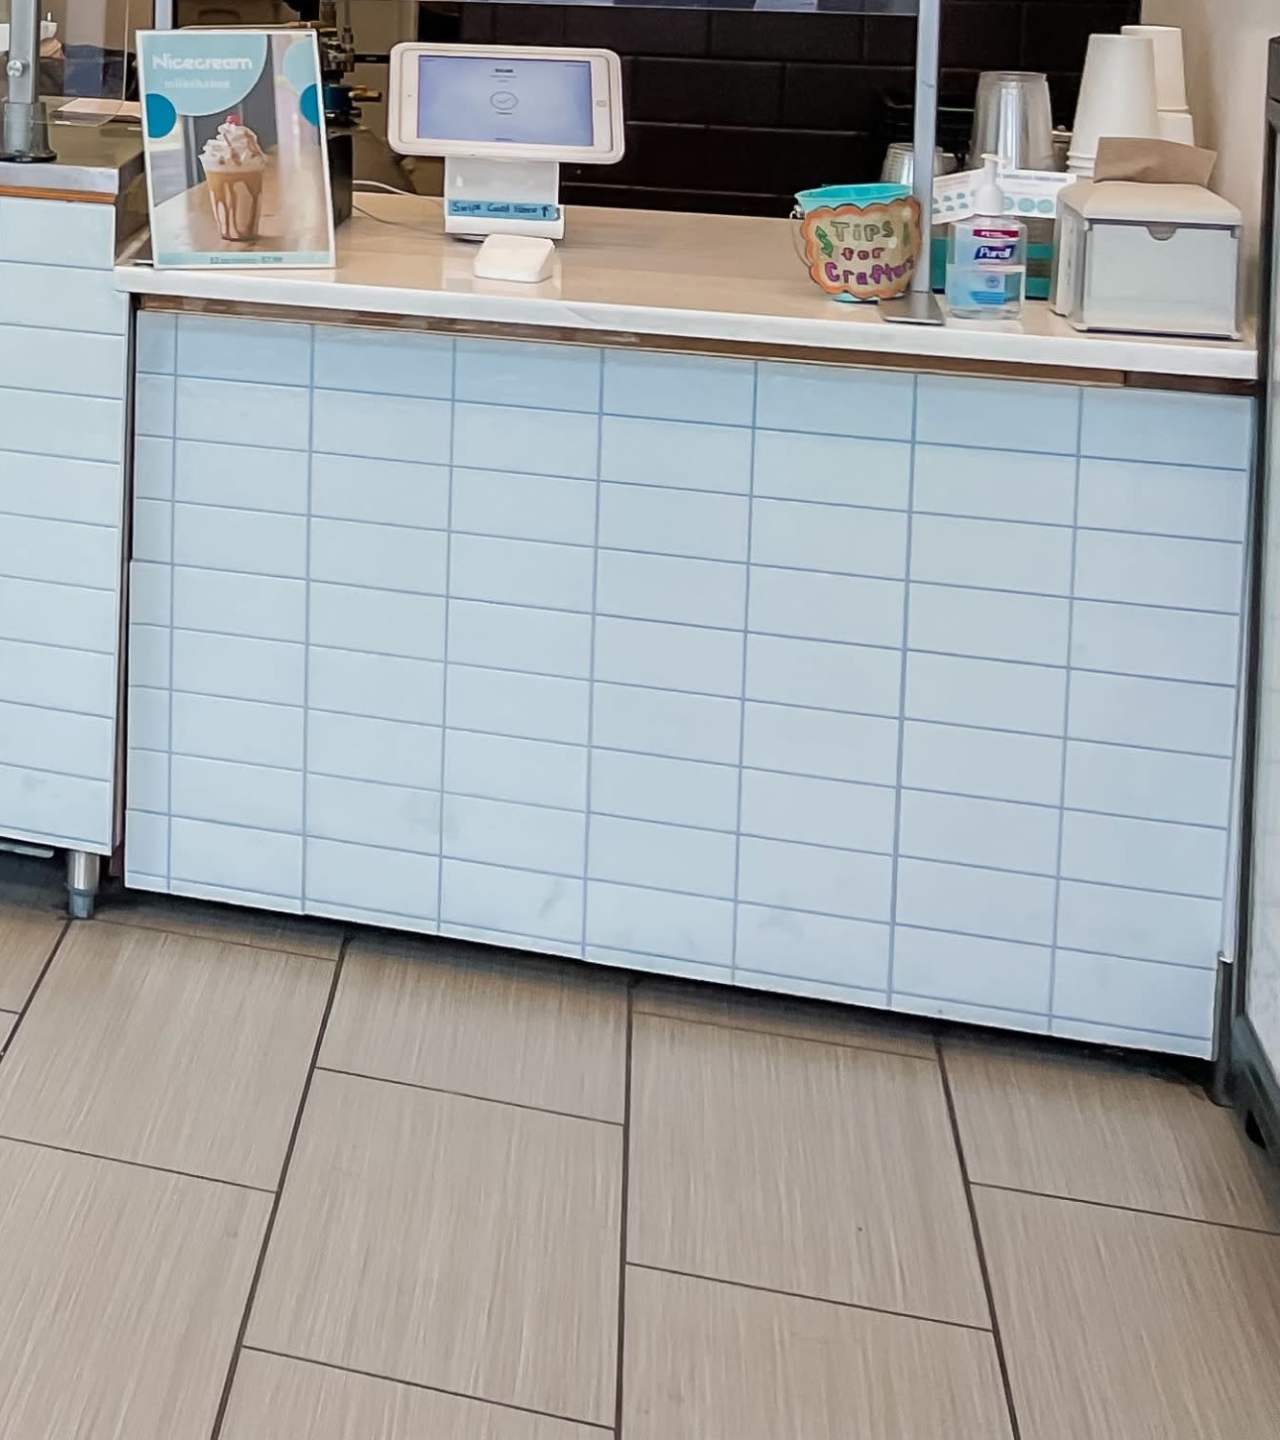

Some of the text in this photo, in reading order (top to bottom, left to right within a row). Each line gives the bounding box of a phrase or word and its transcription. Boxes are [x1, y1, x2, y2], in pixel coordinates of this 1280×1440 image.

[152, 54, 253, 70] Nicecream
[831, 220, 894, 242] Tips
[841, 247, 884, 260] for
